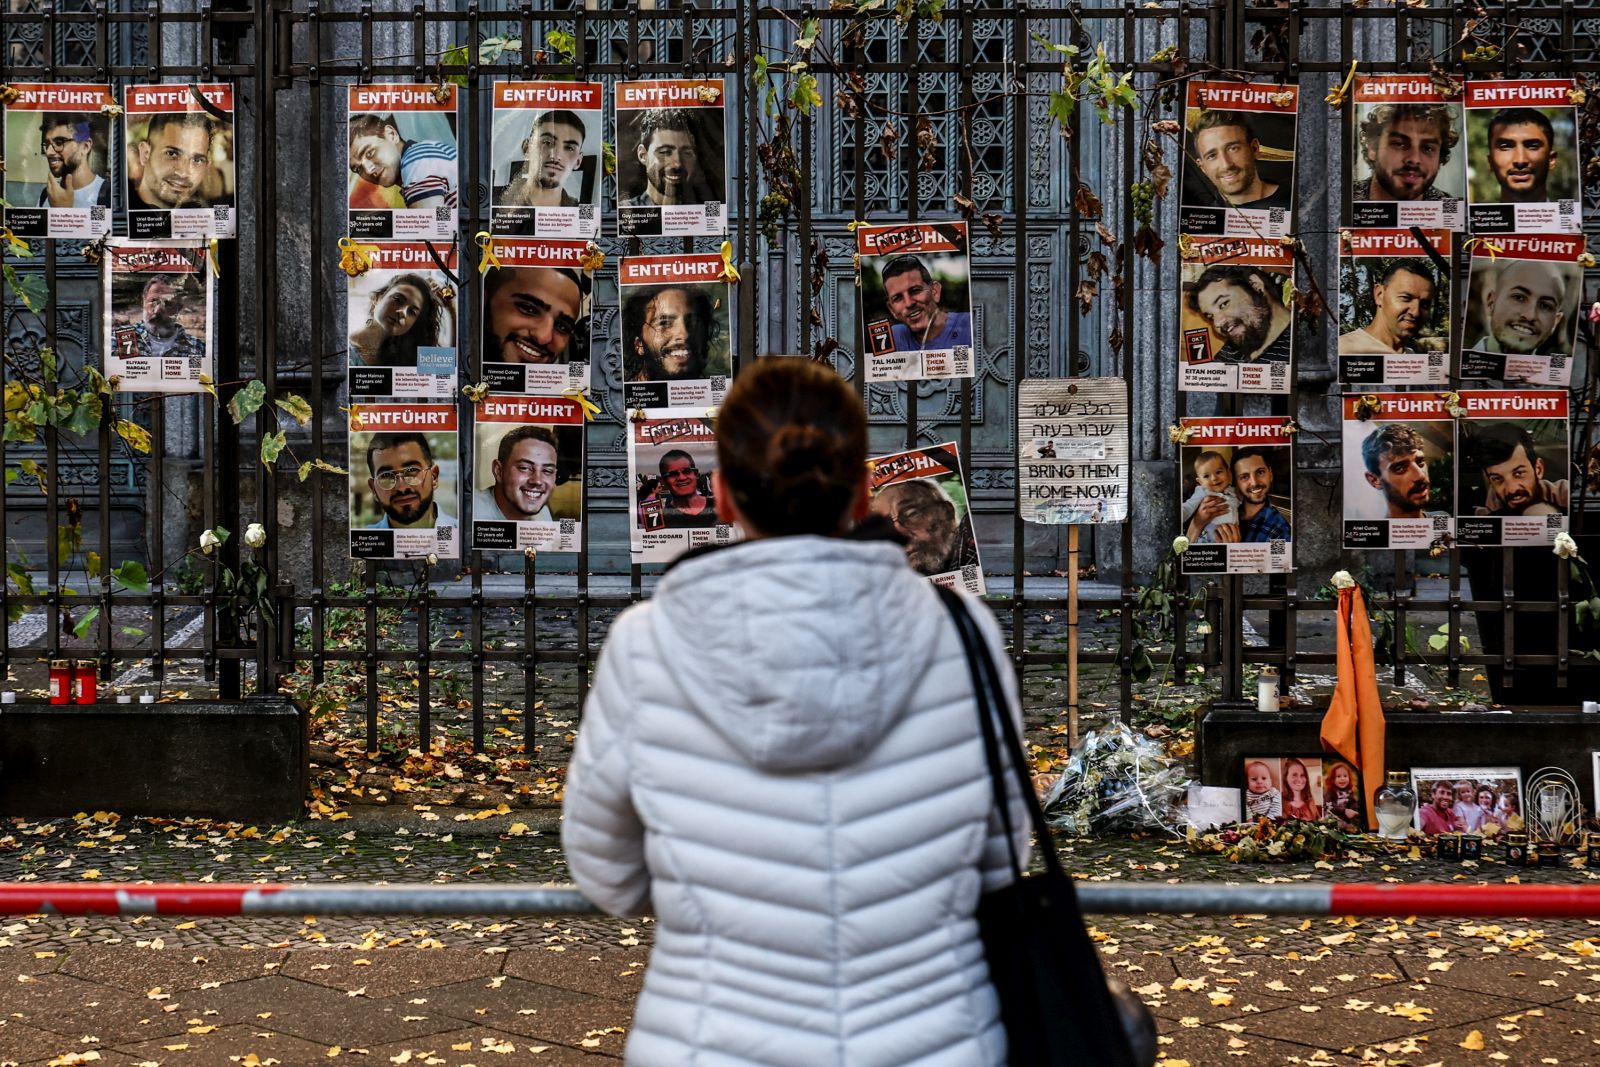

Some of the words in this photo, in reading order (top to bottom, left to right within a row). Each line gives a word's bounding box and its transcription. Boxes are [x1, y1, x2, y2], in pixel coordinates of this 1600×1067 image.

[625, 86, 698, 101] ENTFÜH
[1363, 80, 1438, 95] ENTFÜH
[1473, 86, 1566, 100] ENTFÜHRT
[17, 89, 104, 104] ENTFÜHRT
[503, 88, 593, 102] ENTFÜHRT
[1352, 234, 1442, 248] ENTFÜHT
[1483, 237, 1576, 254] ENTFÜHRT
[497, 245, 584, 260] ENTFÜHRT
[628, 261, 719, 277] ENTFÜHRT
[122, 341, 133, 355] 7
[876, 334, 887, 351] 7
[419, 354, 453, 363] believe
[1192, 343, 1205, 360] 7
[484, 402, 575, 417] ENTFÜHRT
[1467, 397, 1559, 411] ENTFÜHRT
[359, 410, 448, 424] ENTFÜHRT
[1032, 424, 1074, 437] בעזה
[1078, 424, 1114, 437] שבוי
[1191, 423, 1281, 438] ENTFÜHRT
[1028, 464, 1075, 478] BRING
[1079, 464, 1119, 478] THEM
[648, 513, 659, 527] 7
[935, 574, 956, 583] BRING
